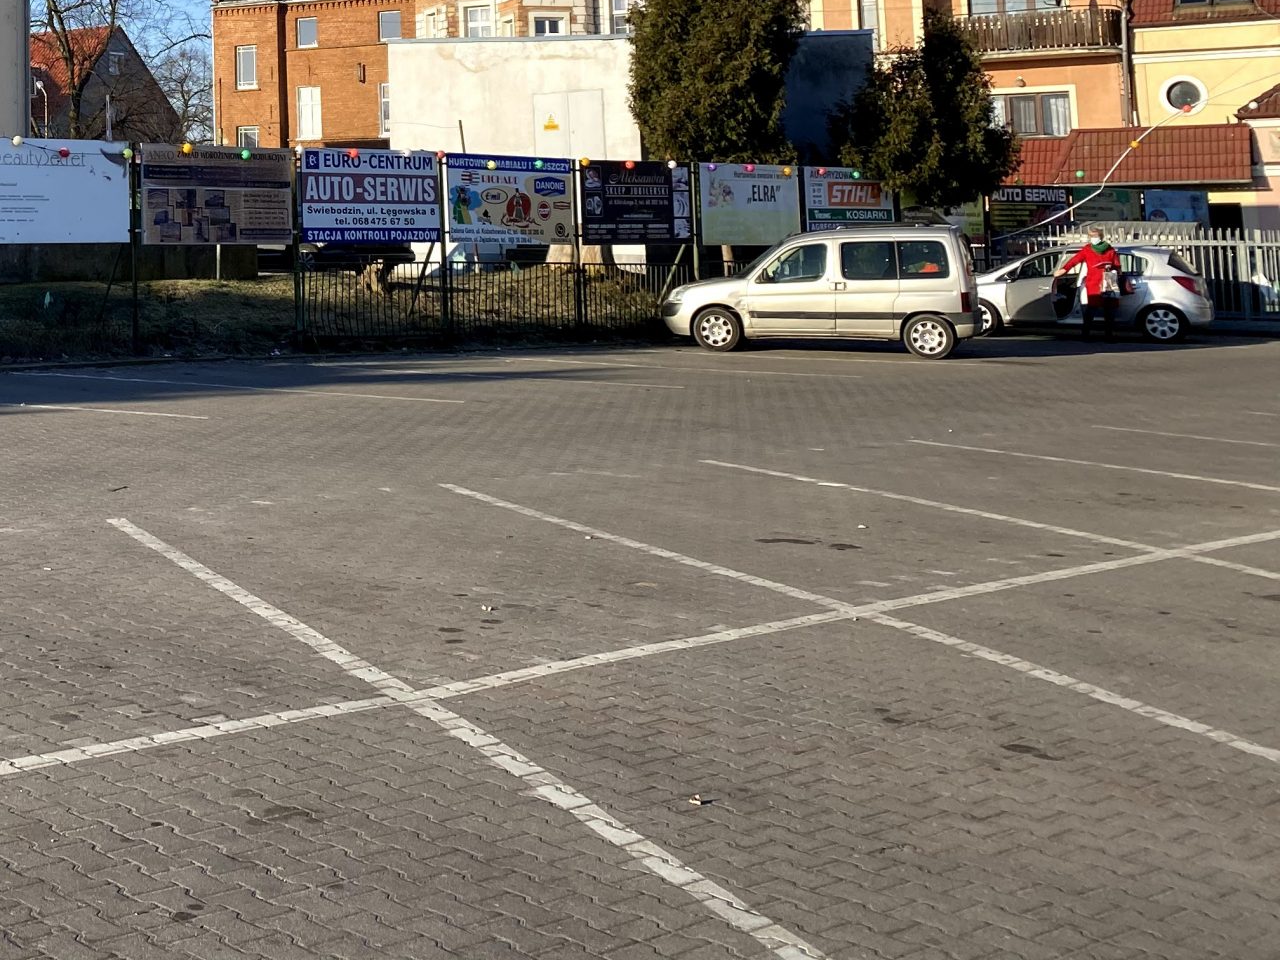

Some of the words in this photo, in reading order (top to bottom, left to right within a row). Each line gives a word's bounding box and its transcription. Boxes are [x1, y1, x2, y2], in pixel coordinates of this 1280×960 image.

[324, 153, 433, 170] EURO-CENTRUM
[305, 175, 436, 202] AUTO-SERWIS
[535, 181, 565, 190] DANONE
[605, 187, 626, 195] SKLEP
[831, 185, 876, 203] STIHL
[992, 189, 1021, 201] AUTO
[1025, 189, 1067, 201] SERWIS
[307, 205, 364, 216] Świebodzin,
[367, 207, 378, 215] ul.
[846, 210, 887, 219] KOSIARKI
[353, 217, 369, 225] 068
[370, 217, 387, 225] 475
[307, 230, 342, 240] STACJA
[344, 230, 388, 240] KONTROLI
[391, 229, 438, 240] POJAZDÓW
